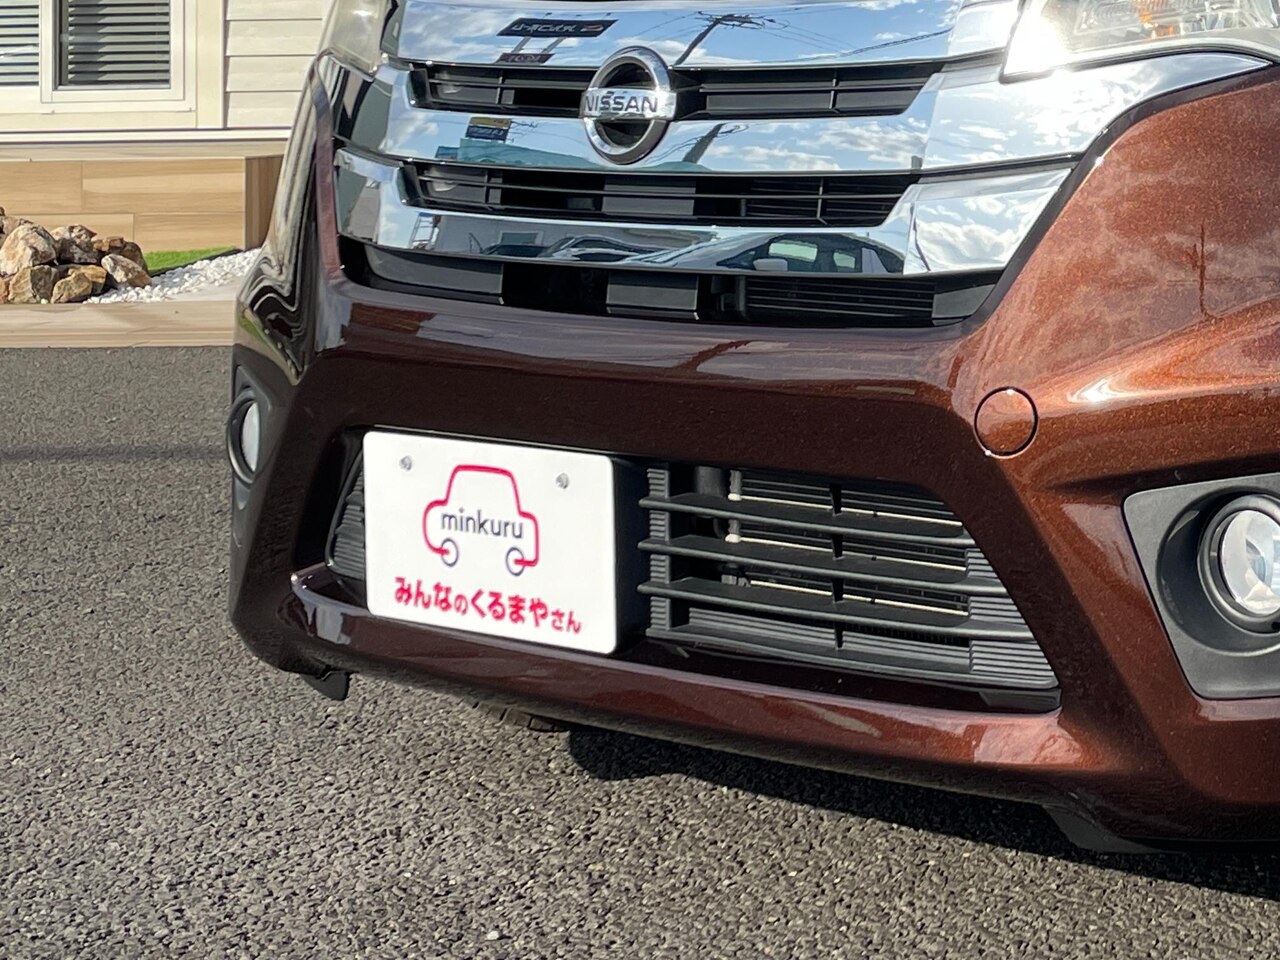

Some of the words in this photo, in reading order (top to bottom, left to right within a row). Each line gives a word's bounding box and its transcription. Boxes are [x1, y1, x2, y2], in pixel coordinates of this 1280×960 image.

[584, 95, 658, 113] NISSAN
[441, 508, 524, 539] minkuru
[394, 576, 582, 635] みんなのくるまやさん
